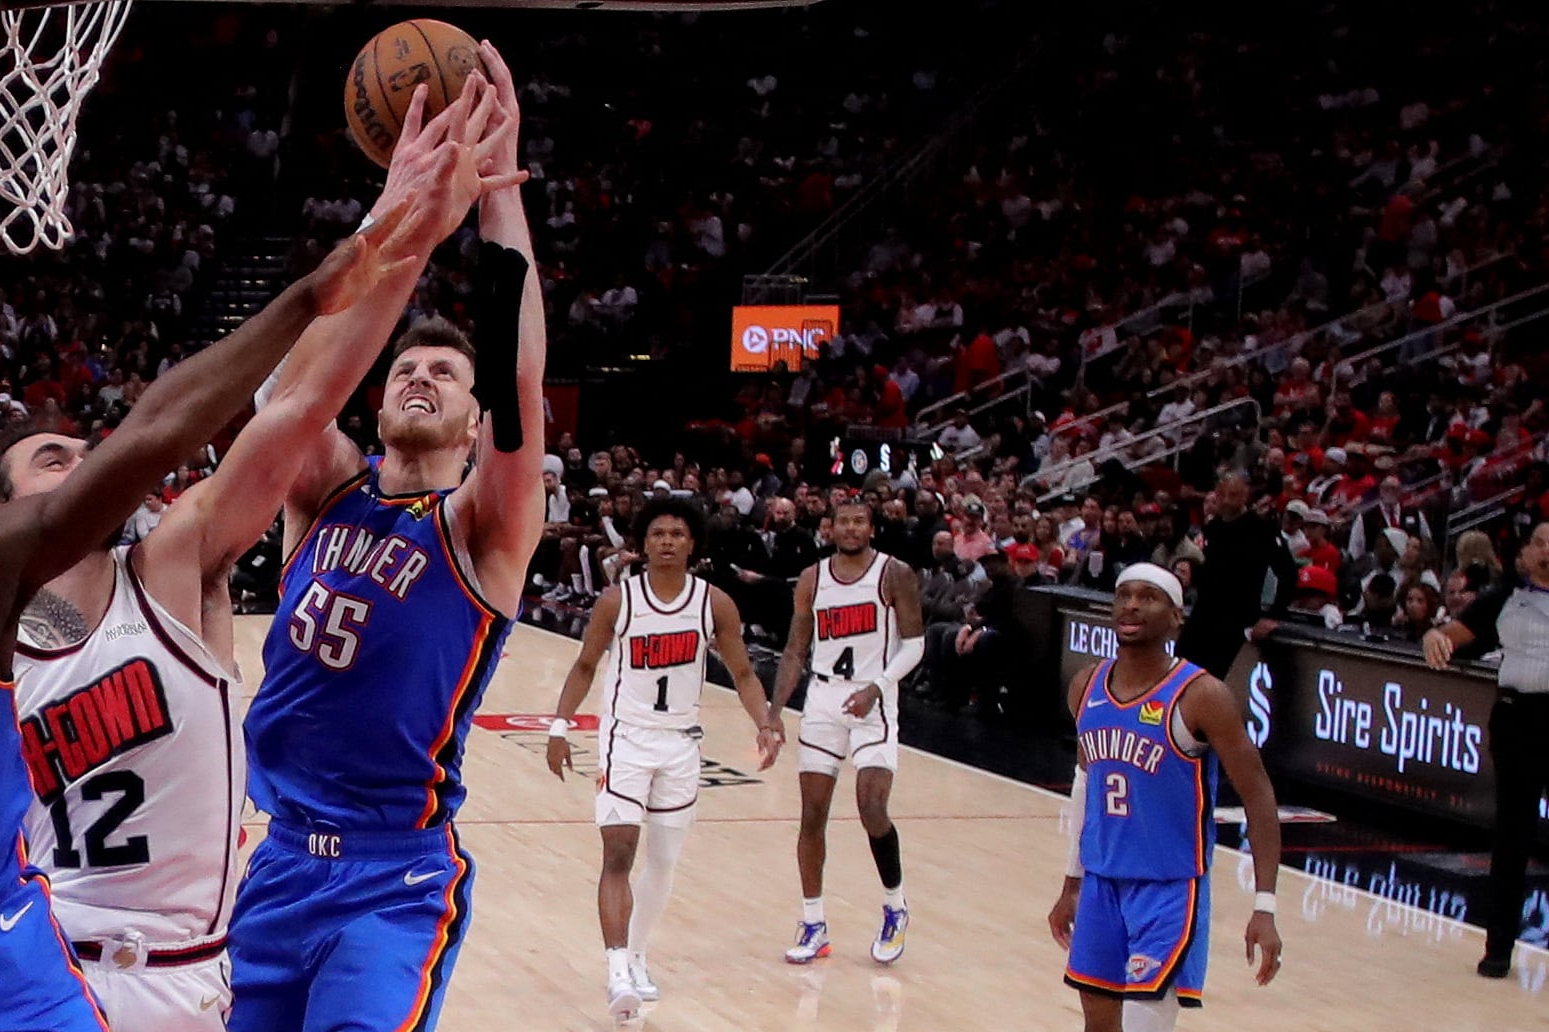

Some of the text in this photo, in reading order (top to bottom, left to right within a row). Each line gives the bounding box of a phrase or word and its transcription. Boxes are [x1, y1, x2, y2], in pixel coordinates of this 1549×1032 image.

[771, 327, 825, 351] PNC
[290, 580, 370, 669] 55
[832, 646, 855, 680] 4
[654, 675, 669, 711] 1
[1315, 668, 1482, 775] Sire Spirits
[1079, 729, 1165, 774] THUNDER
[1105, 772, 1128, 817] 2
[50, 769, 150, 869] 12
[309, 833, 341, 857] OKC
